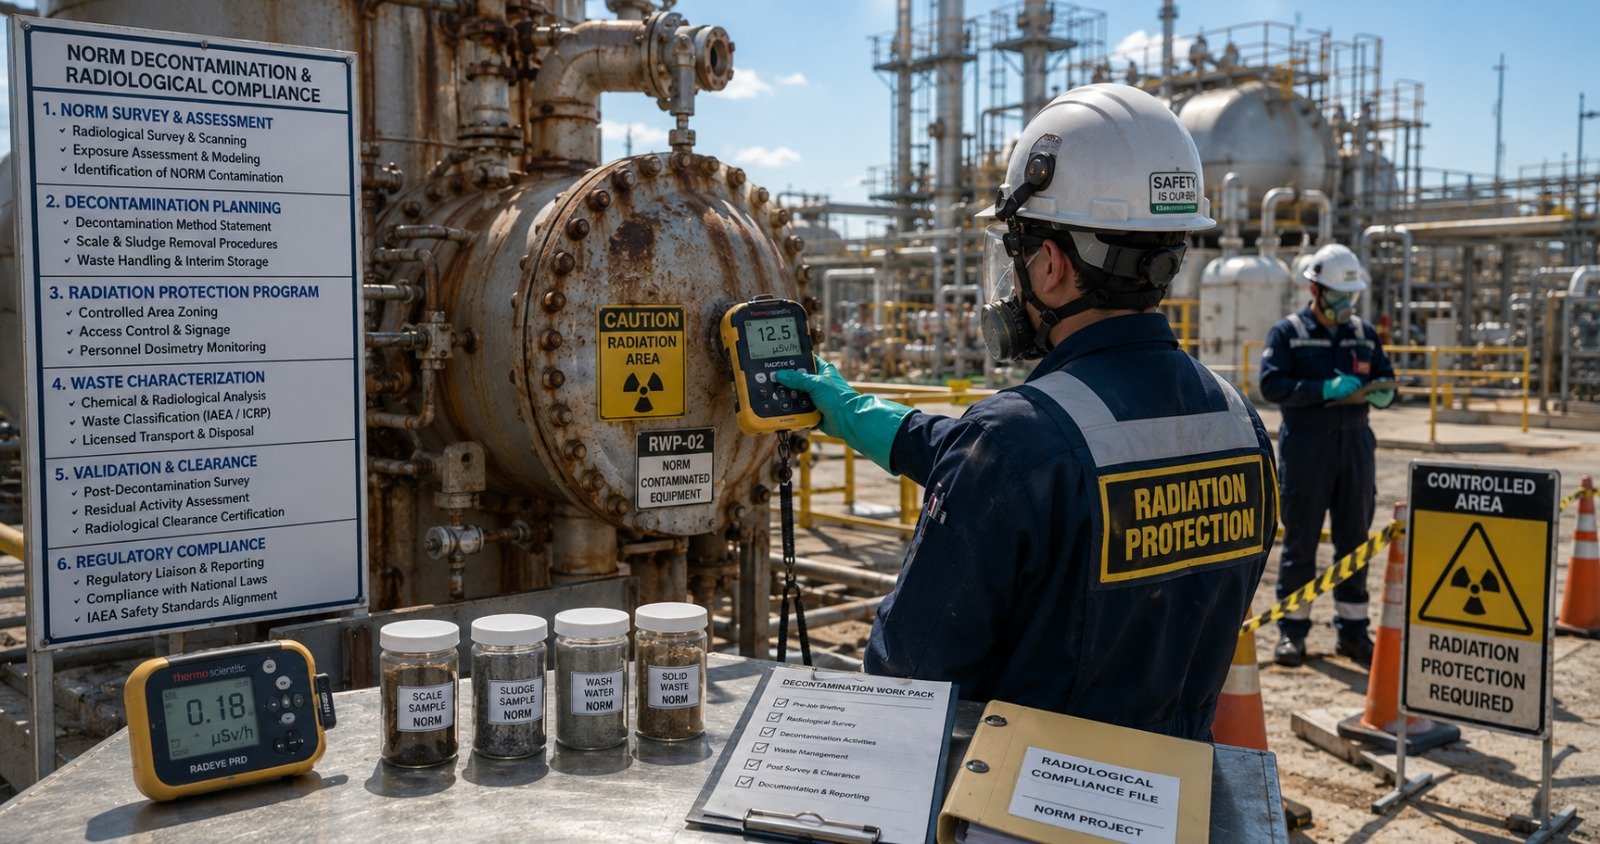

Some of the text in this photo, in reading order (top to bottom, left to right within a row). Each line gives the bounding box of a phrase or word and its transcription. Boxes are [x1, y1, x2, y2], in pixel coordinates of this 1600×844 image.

[67, 44, 312, 82] NORM DECONTAMINATION &
[65, 66, 321, 103] RADIOLOGICAL COMPLIANCE
[42, 102, 273, 130] 1. NORM SURVEY & ASSESSMENT
[72, 125, 247, 148] Radiological Survey & Scanning
[73, 145, 261, 167] Exposure Assessment & Modeling
[73, 163, 284, 183] Identification of NORM Contamination
[1153, 176, 1196, 189] SAFETY
[46, 195, 281, 215] 2. DECONTAMINATION PLANNING
[1158, 192, 1167, 201] IS
[76, 217, 272, 232] Decontamination Method Statement
[76, 236, 278, 251] Scale & Sludge Removal Procedures
[77, 254, 269, 269] Waste Handling & Interim Storage
[49, 286, 319, 300] 3. RADIATION PROTECTION PROGRAM
[78, 306, 218, 320] Controlled Area Zoning
[605, 311, 679, 329] CAUTION
[79, 324, 231, 339] Access Control & Signage
[757, 325, 791, 342] 12.5
[80, 341, 266, 357] Personnel Dosimetry Monitoring
[607, 335, 677, 349] RADIATION
[626, 352, 660, 366] AREA
[52, 370, 265, 391] 4. WASTE CHARACTERIZATION
[81, 390, 266, 409] Chemical & Radiological Analysis
[82, 407, 271, 428] Waste Classification (IAEA / ICRP)
[82, 425, 254, 446] Licensed Transport & Disposal
[649, 434, 705, 451] RWP-02
[55, 455, 258, 481] 5. VALIDATION & CLEARANCE
[662, 459, 691, 471] NORM
[83, 475, 250, 498] Post-Decontamination Survey
[640, 474, 710, 488] CONTAMINATED
[1427, 472, 1536, 496] CONTROLLED
[650, 489, 702, 503] EQUIPMENT
[1134, 472, 1247, 521] RADIATION
[1454, 493, 1503, 513] AREA
[84, 493, 250, 517] Residual Activity Assessment
[84, 506, 285, 536] Radiological Clearance Certification
[1125, 508, 1255, 561] PROTECTION
[57, 537, 266, 571] 6. REGULATORY COMPLIANCE
[86, 556, 264, 588] Regulatory Liaison & Reporting
[86, 573, 268, 606] Compliance with National Laws
[87, 589, 278, 624] IAEA Safety Standards Alignment
[1429, 634, 1519, 664] RADIATION
[173, 670, 209, 683] thermo
[585, 677, 612, 687] WASH
[662, 672, 688, 681] SOLID
[1421, 657, 1526, 690] PROTECTION
[412, 690, 443, 700] SCALE
[500, 683, 535, 695] SLUDGE
[584, 687, 614, 698] WATER
[660, 681, 690, 692] WASTE
[782, 679, 935, 699] DECONTAMINATION WORK PACK
[408, 701, 446, 712] SAMPLE
[499, 695, 536, 707] SAMPLE
[586, 700, 613, 711] NORM
[662, 694, 688, 704] NORM
[793, 701, 846, 712] Pre-Job Briefing
[1429, 683, 1514, 713] REQUIRED
[186, 692, 245, 726] 0.18
[503, 708, 532, 720] NORM
[413, 715, 442, 727] NORM
[786, 716, 857, 728] Radiological Survey
[780, 731, 877, 746] Decontamination Activities
[798, 750, 848, 760] Management
[189, 755, 248, 773] RADEYE PRD
[766, 763, 783, 772] Post
[785, 765, 811, 775] Survey
[820, 769, 860, 780] Clearance
[1041, 756, 1154, 789] RADIOLOGICAL
[758, 780, 820, 795] Documentation
[829, 789, 870, 802] Reporting
[1031, 769, 1159, 804] COMPLIANCE FILE
[1034, 803, 1144, 837] NORM PROJECT
